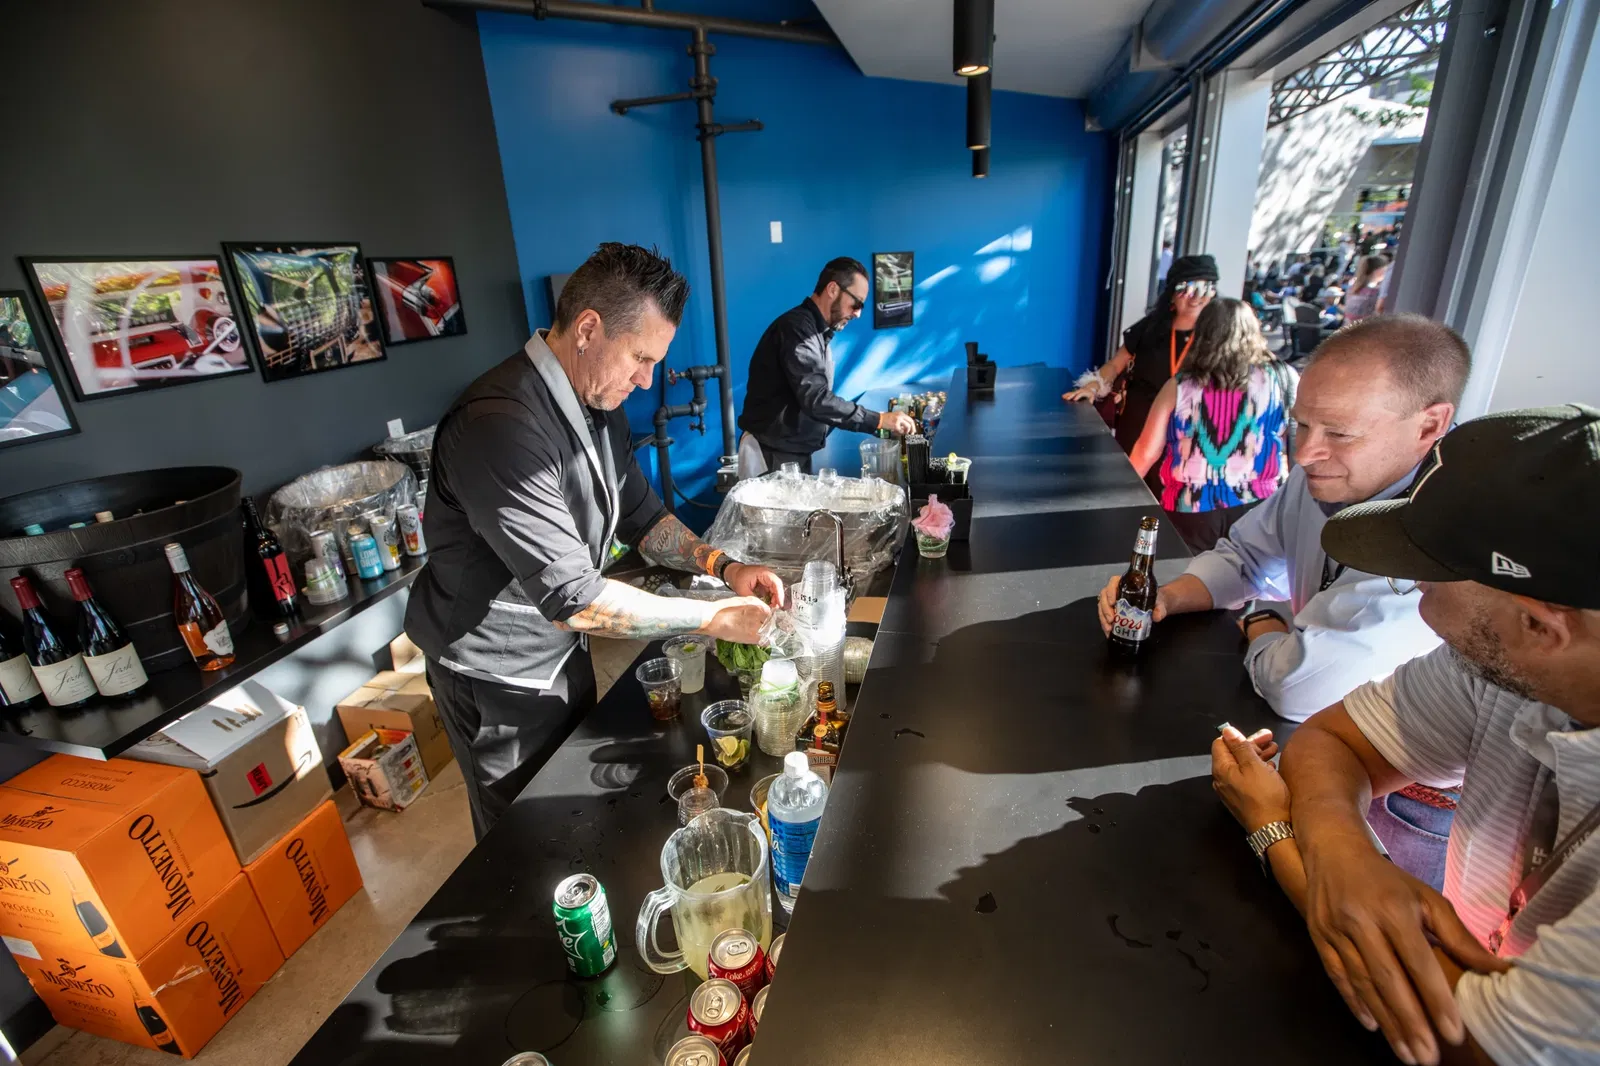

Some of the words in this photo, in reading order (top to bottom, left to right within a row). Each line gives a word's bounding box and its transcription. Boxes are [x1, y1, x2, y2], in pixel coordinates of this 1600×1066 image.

[1112, 613, 1143, 630] oors
[1114, 624, 1138, 638] GHT
[60, 778, 116, 792] PROSECCO
[1, 813, 54, 830] MIONETTO
[128, 814, 195, 921] MIONETTO
[0, 876, 51, 896] NETTO
[285, 838, 330, 925] MIONETTO
[1, 901, 55, 918] PROSECCO
[185, 921, 244, 1017] MIONETTO
[724, 971, 743, 982] Coke
[38, 968, 115, 999] MIONETTO
[67, 1000, 117, 1017] PROSECCO
